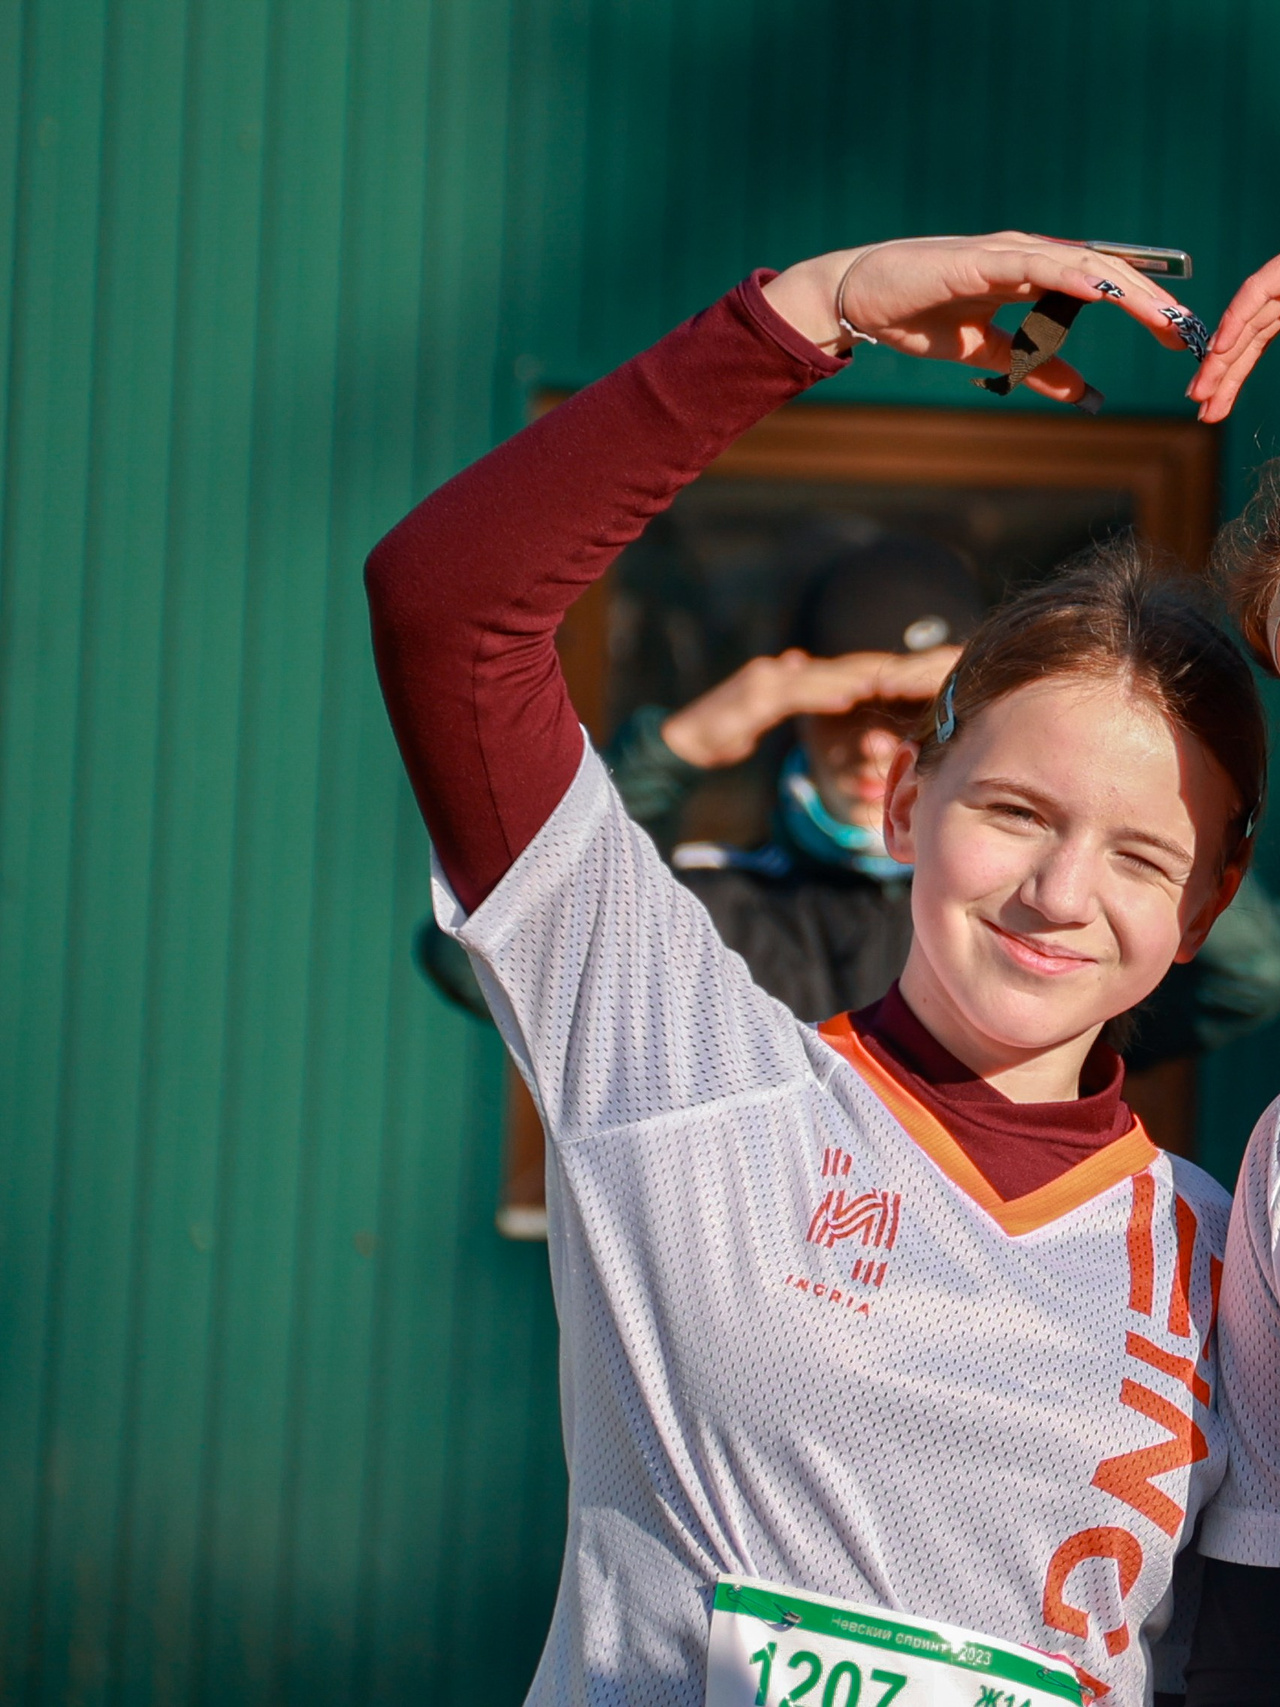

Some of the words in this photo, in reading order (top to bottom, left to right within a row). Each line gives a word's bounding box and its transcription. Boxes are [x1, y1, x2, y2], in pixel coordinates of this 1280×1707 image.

[785, 1274, 871, 1316] INGRIA
[749, 1642, 908, 1707] 1207
[958, 1646, 993, 1665] 2023
